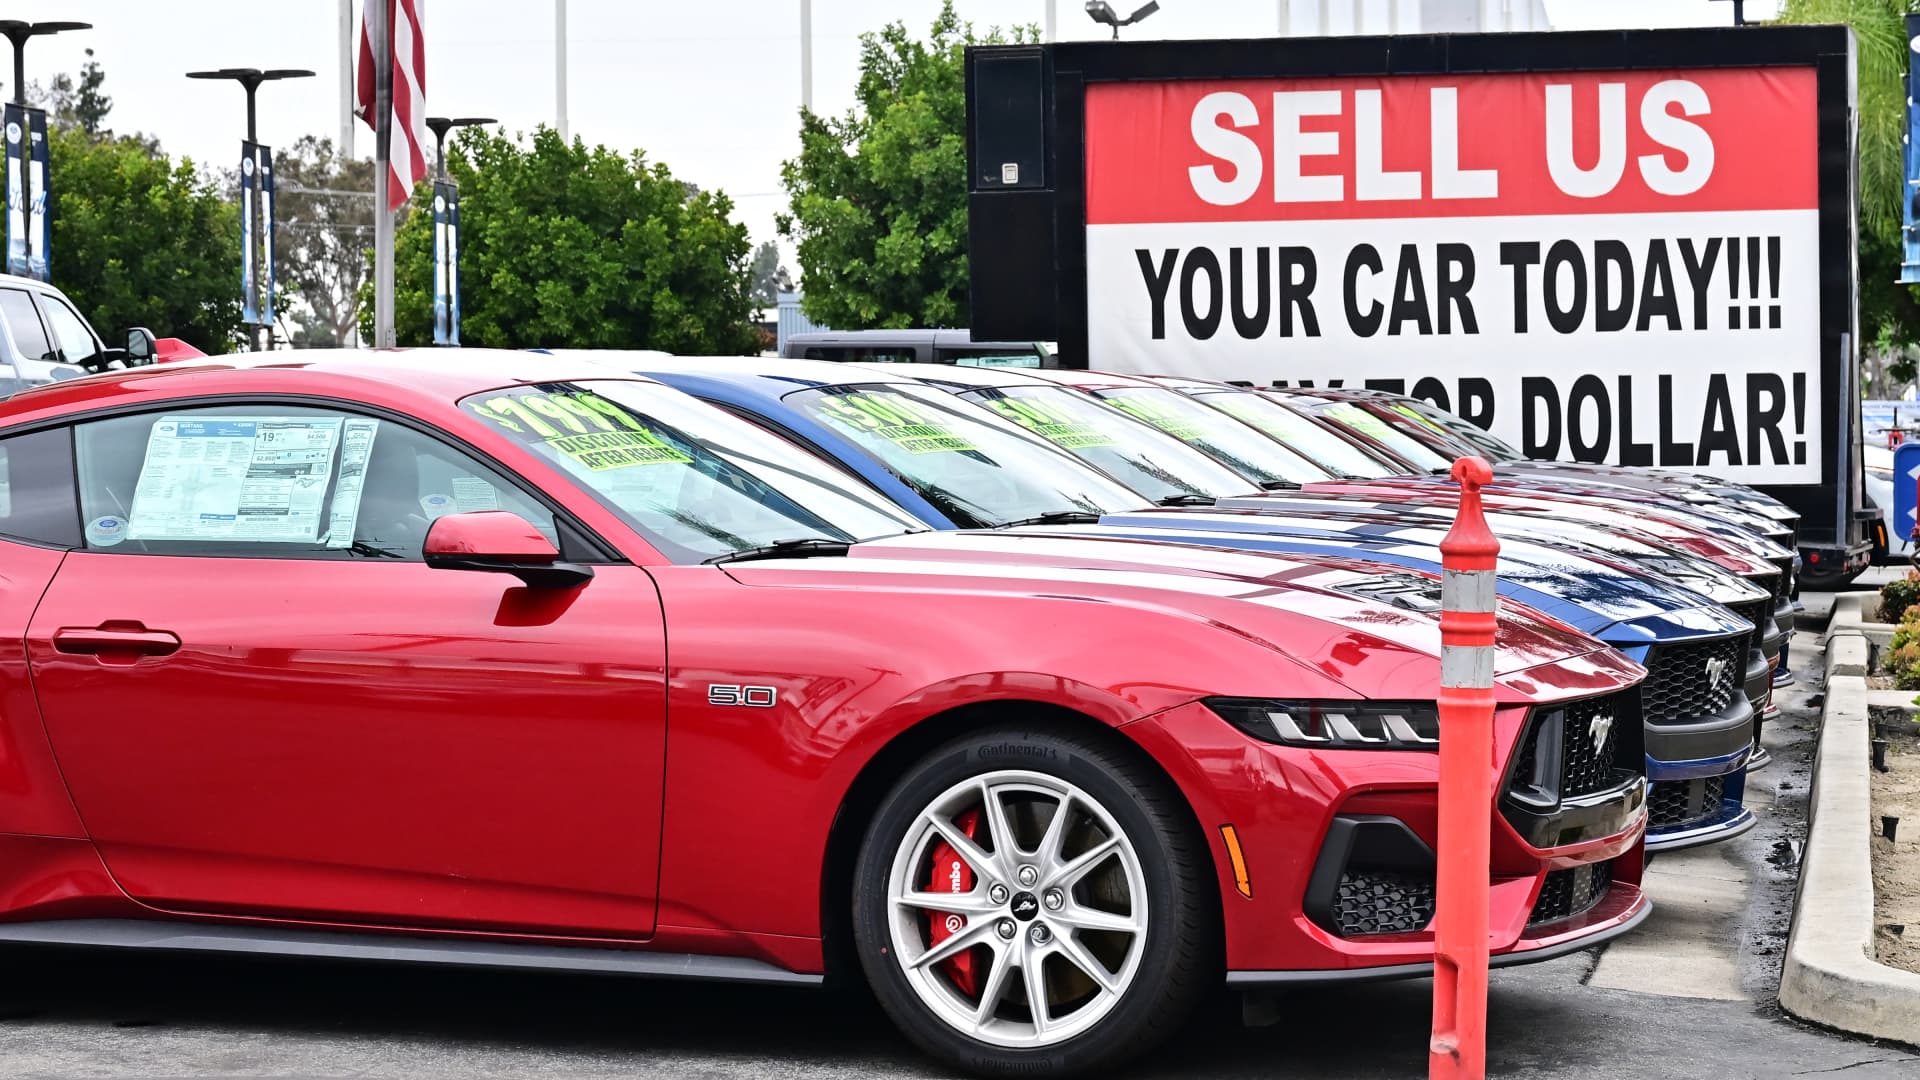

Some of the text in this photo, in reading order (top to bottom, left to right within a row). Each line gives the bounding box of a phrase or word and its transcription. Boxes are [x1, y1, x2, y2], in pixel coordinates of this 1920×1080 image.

[1188, 80, 1715, 206] SELL US
[1135, 235, 1783, 340] YOUR CAR TODAY!!!
[1521, 372, 1808, 467] DOLLAR!
[262, 431, 275, 442] 19
[555, 431, 655, 453] DISCOUNT
[578, 446, 682, 468] AFTER REBATE
[708, 684, 777, 707] 5.0
[949, 861, 961, 893] mbo
